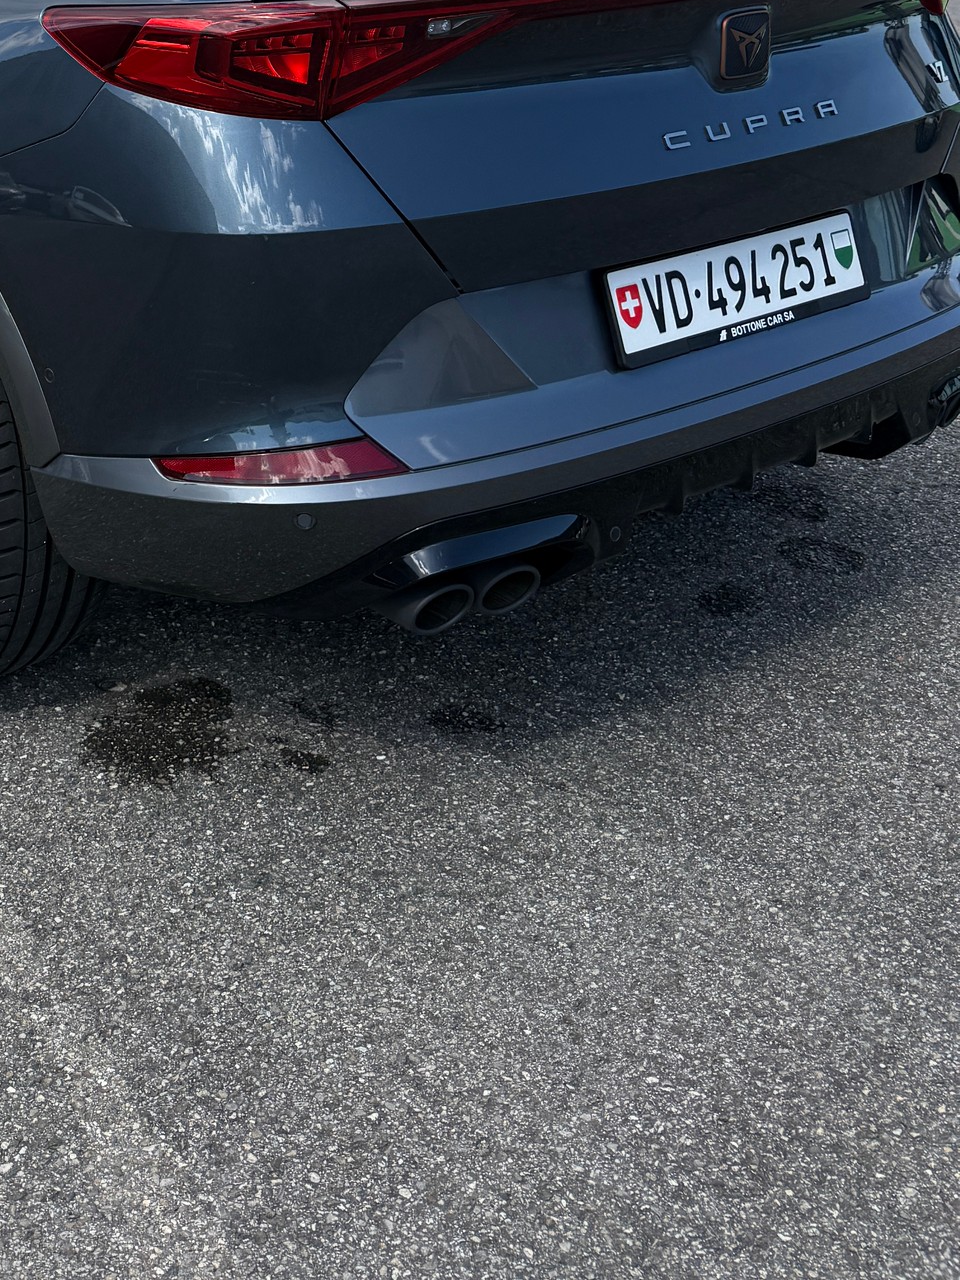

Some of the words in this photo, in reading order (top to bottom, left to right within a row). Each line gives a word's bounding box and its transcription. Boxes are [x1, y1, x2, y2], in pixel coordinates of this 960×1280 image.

[662, 99, 839, 150] CUPRA
[730, 318, 767, 337] BOTTONE
[767, 314, 784, 326] CAR
[784, 310, 795, 322] SA
